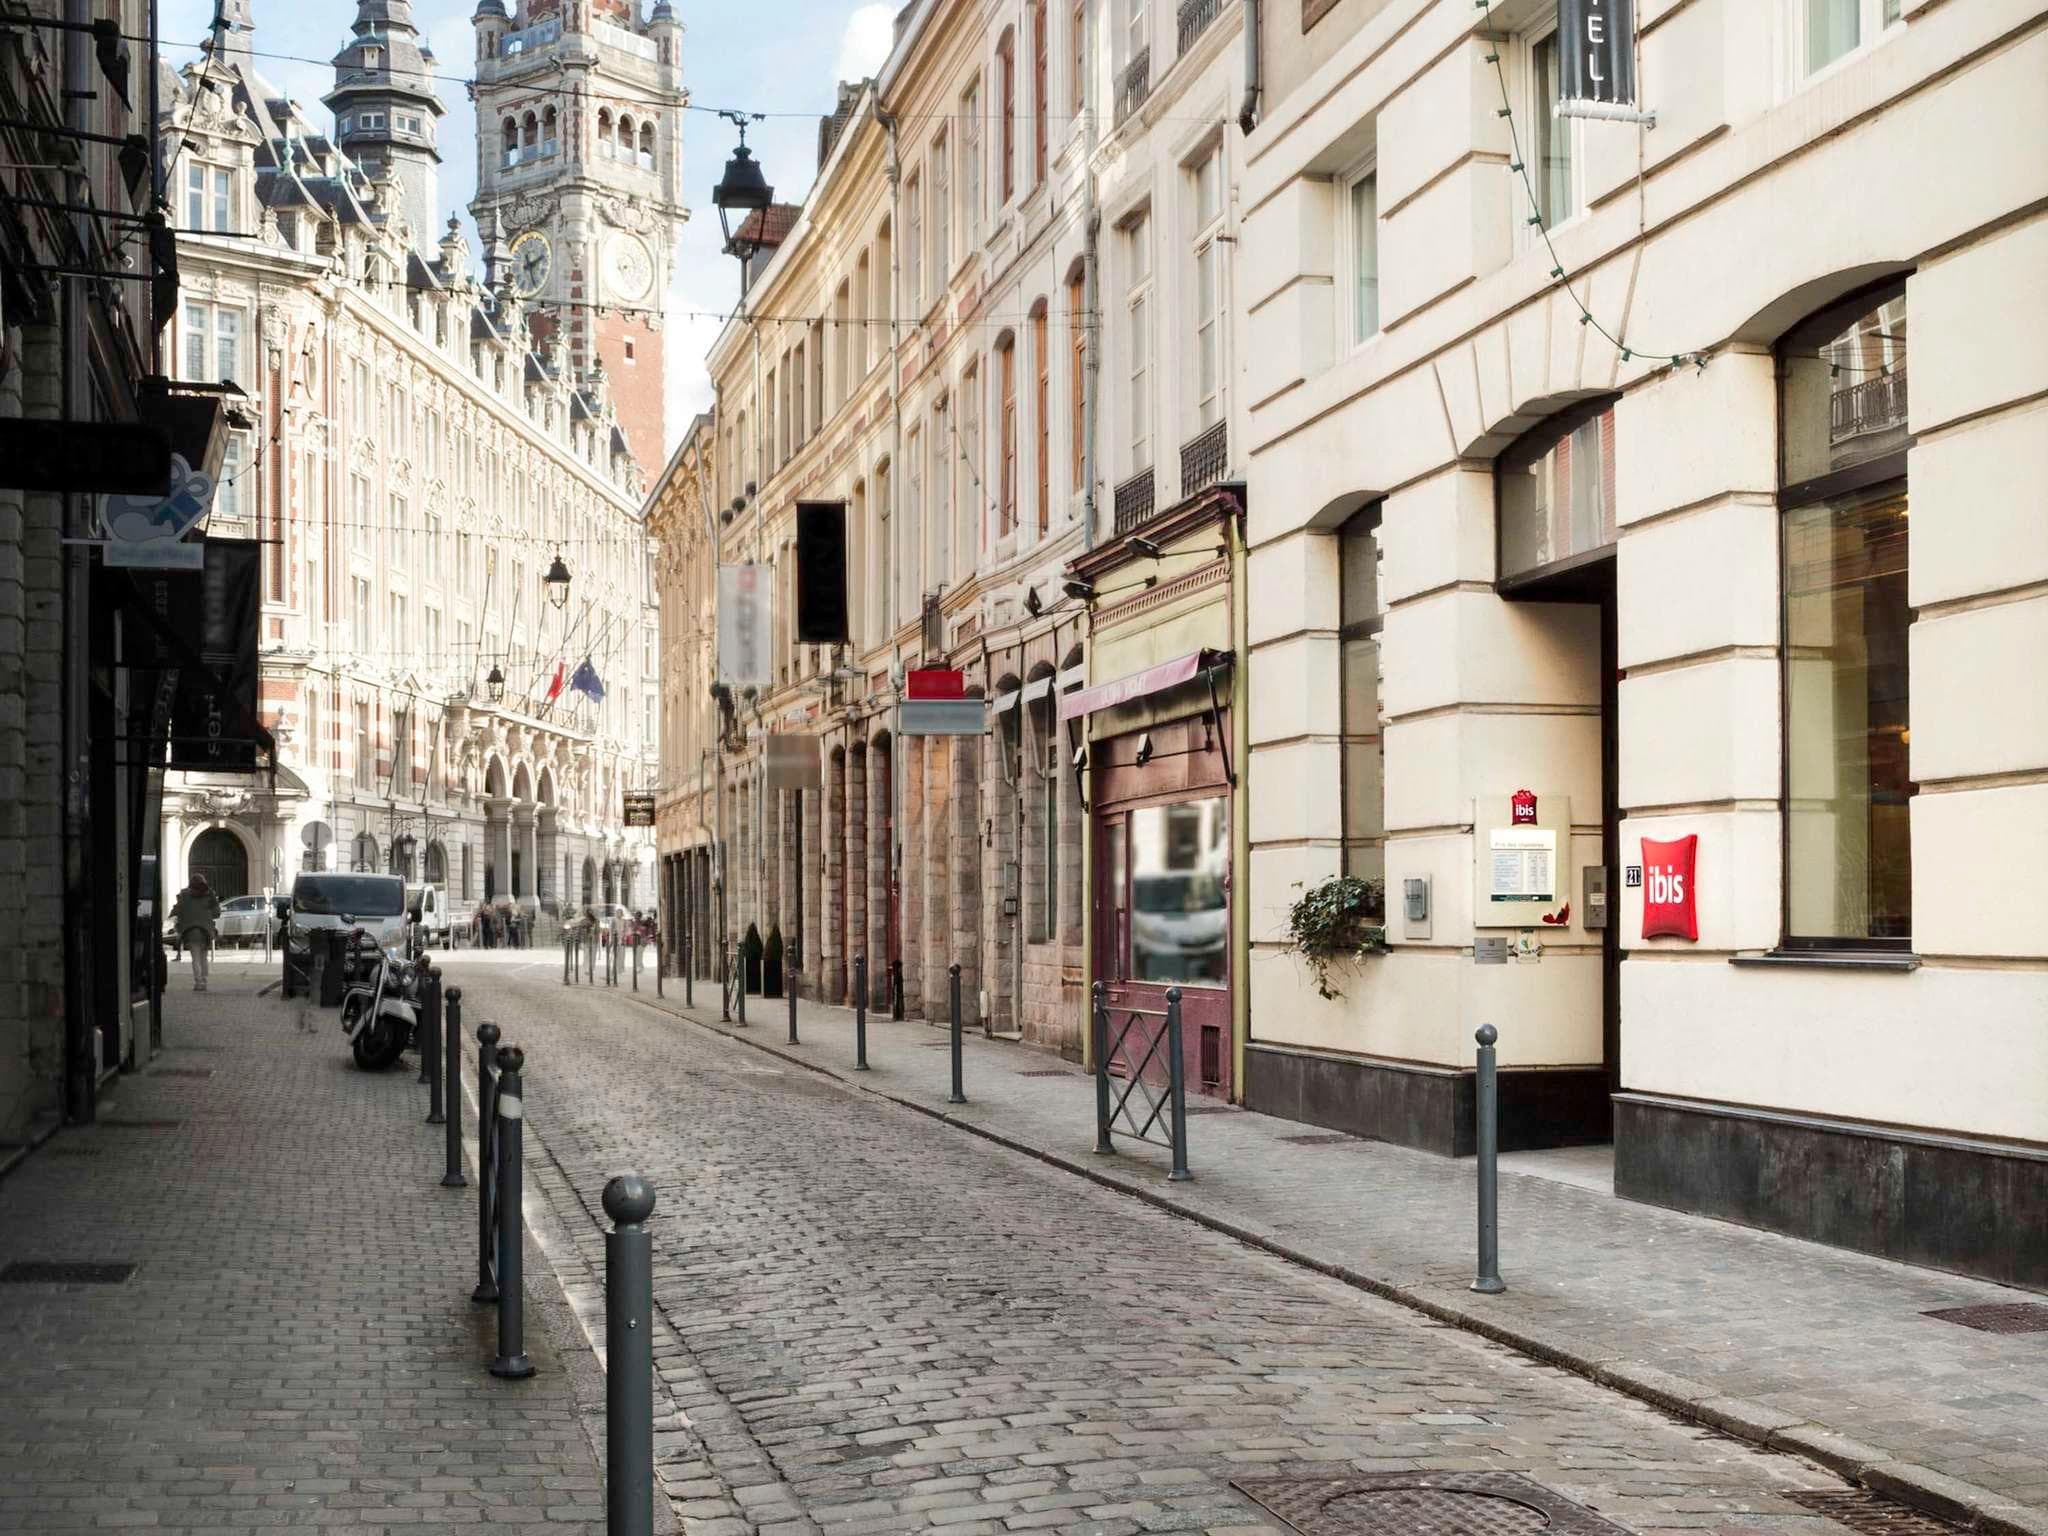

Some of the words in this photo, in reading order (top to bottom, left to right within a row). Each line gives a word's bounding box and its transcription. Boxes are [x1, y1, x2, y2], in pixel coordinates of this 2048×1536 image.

[1587, 0, 1605, 81] EL
[1515, 804, 1535, 817] ibis
[1627, 869, 1639, 884] 21
[1648, 864, 1684, 904] ibis
